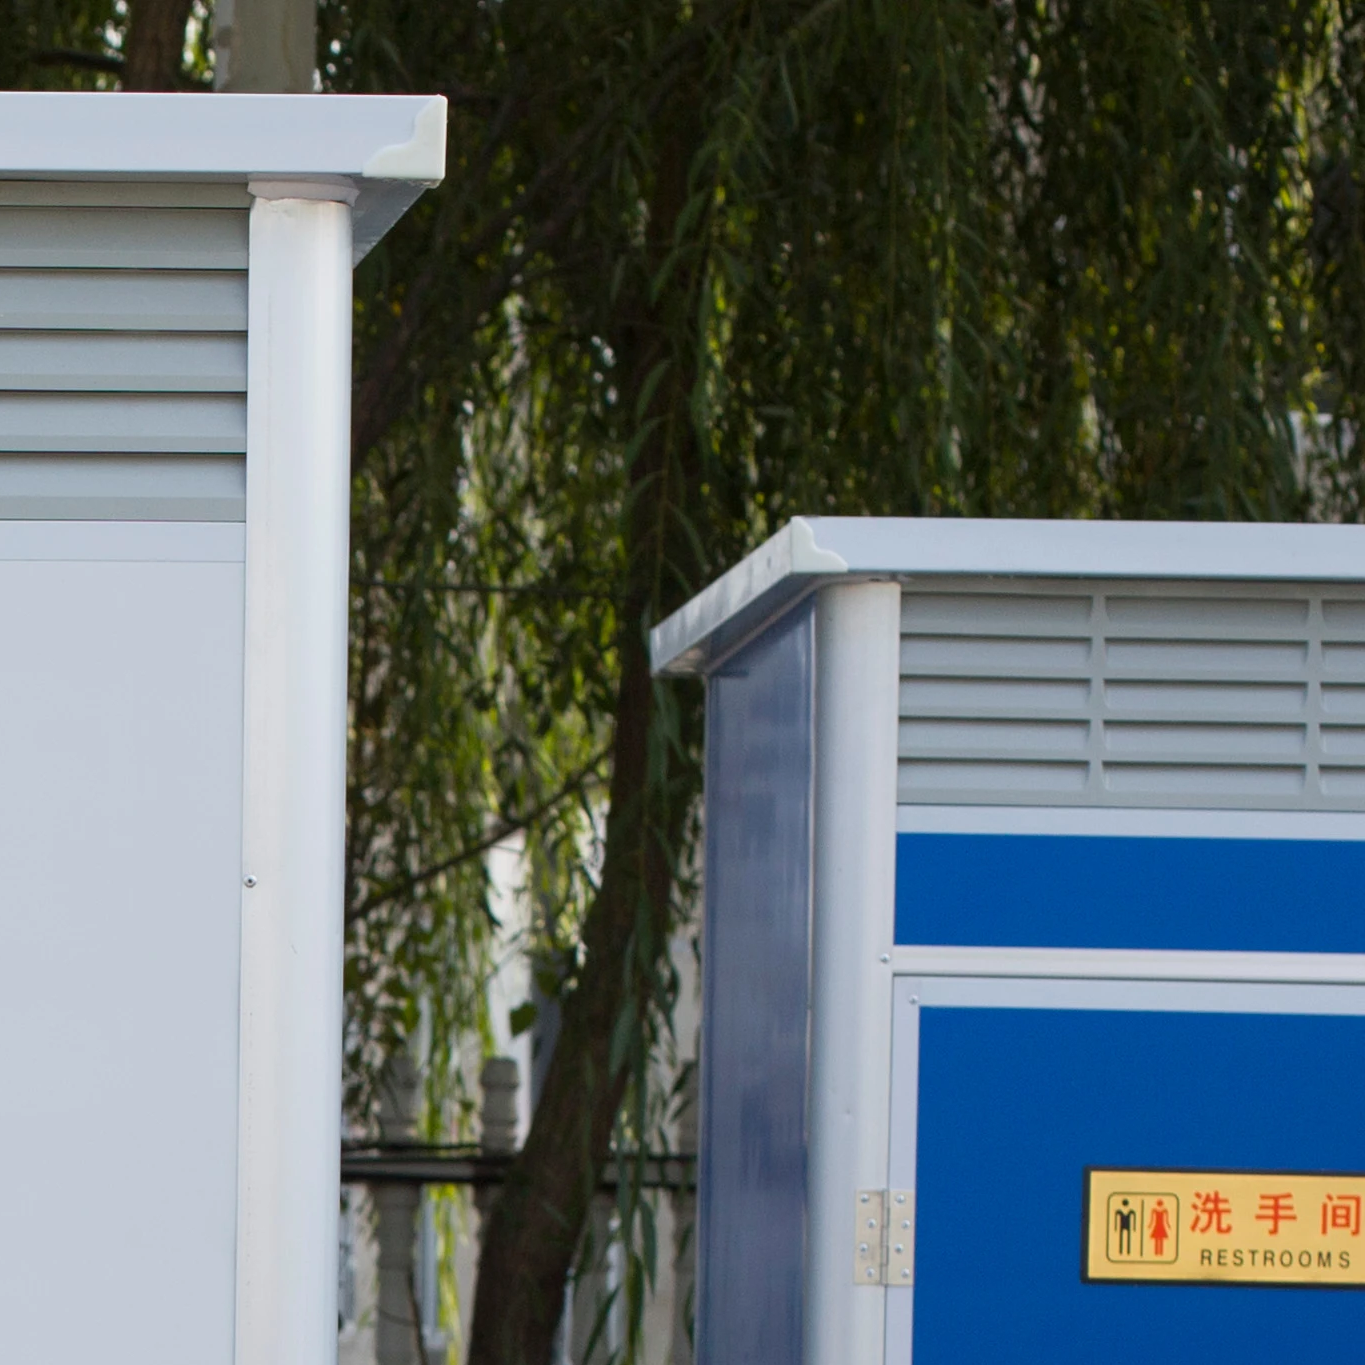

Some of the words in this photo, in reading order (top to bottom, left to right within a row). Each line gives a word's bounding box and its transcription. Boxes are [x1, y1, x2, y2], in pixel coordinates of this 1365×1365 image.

[1189, 1191, 1361, 1237] 洗手间
[1200, 1249, 1351, 1269] RESTROOMS
